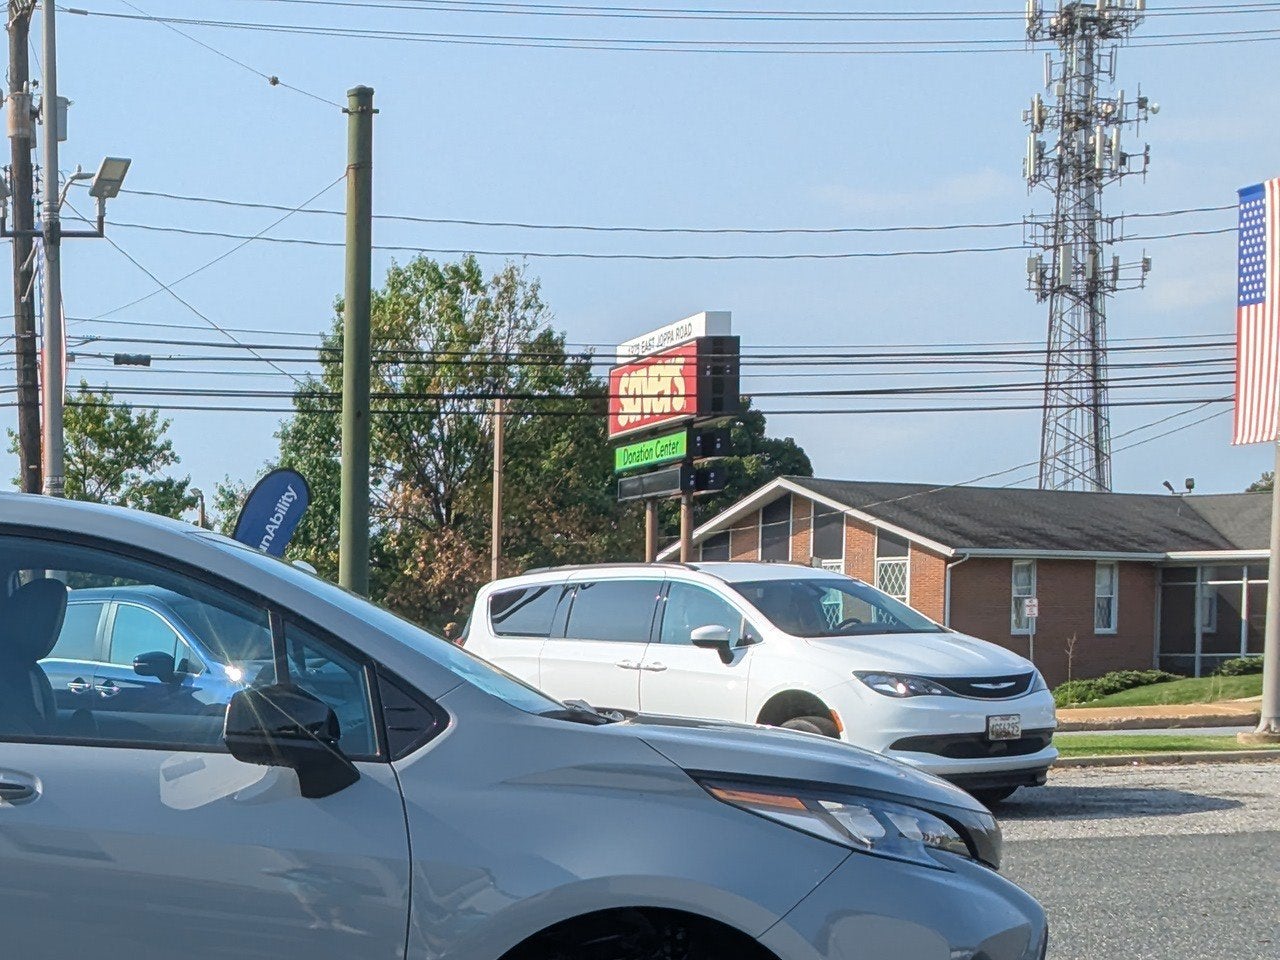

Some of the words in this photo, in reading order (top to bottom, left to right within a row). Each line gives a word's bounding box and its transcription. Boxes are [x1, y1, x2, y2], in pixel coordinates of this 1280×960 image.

[641, 336, 655, 354] EAST
[656, 329, 674, 348] JOPPA
[675, 322, 693, 340] ROAD
[623, 445, 654, 465] Donation
[655, 440, 680, 457] Center
